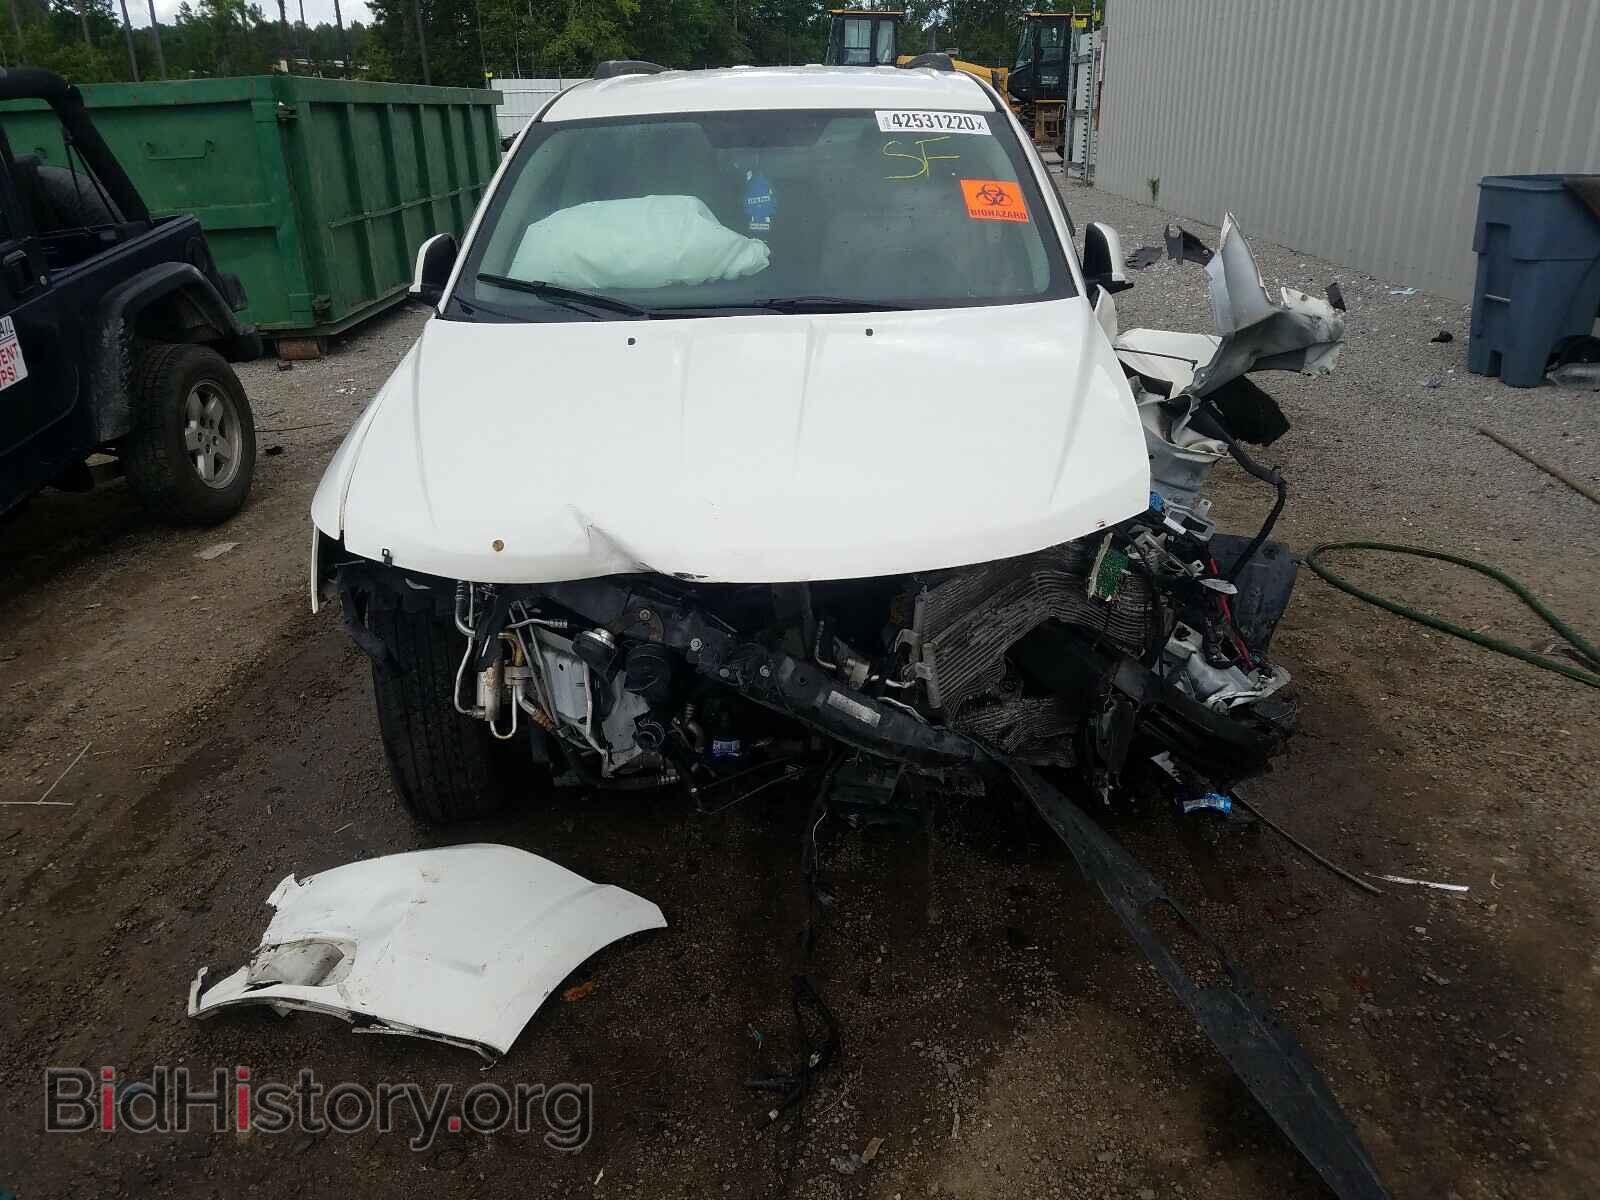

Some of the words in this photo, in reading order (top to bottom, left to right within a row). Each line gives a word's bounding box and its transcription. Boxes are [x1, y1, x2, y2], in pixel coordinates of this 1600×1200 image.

[892, 113, 975, 131] 42531220
[970, 208, 1027, 220] BIOHAZARD
[0, 342, 18, 365] ENT
